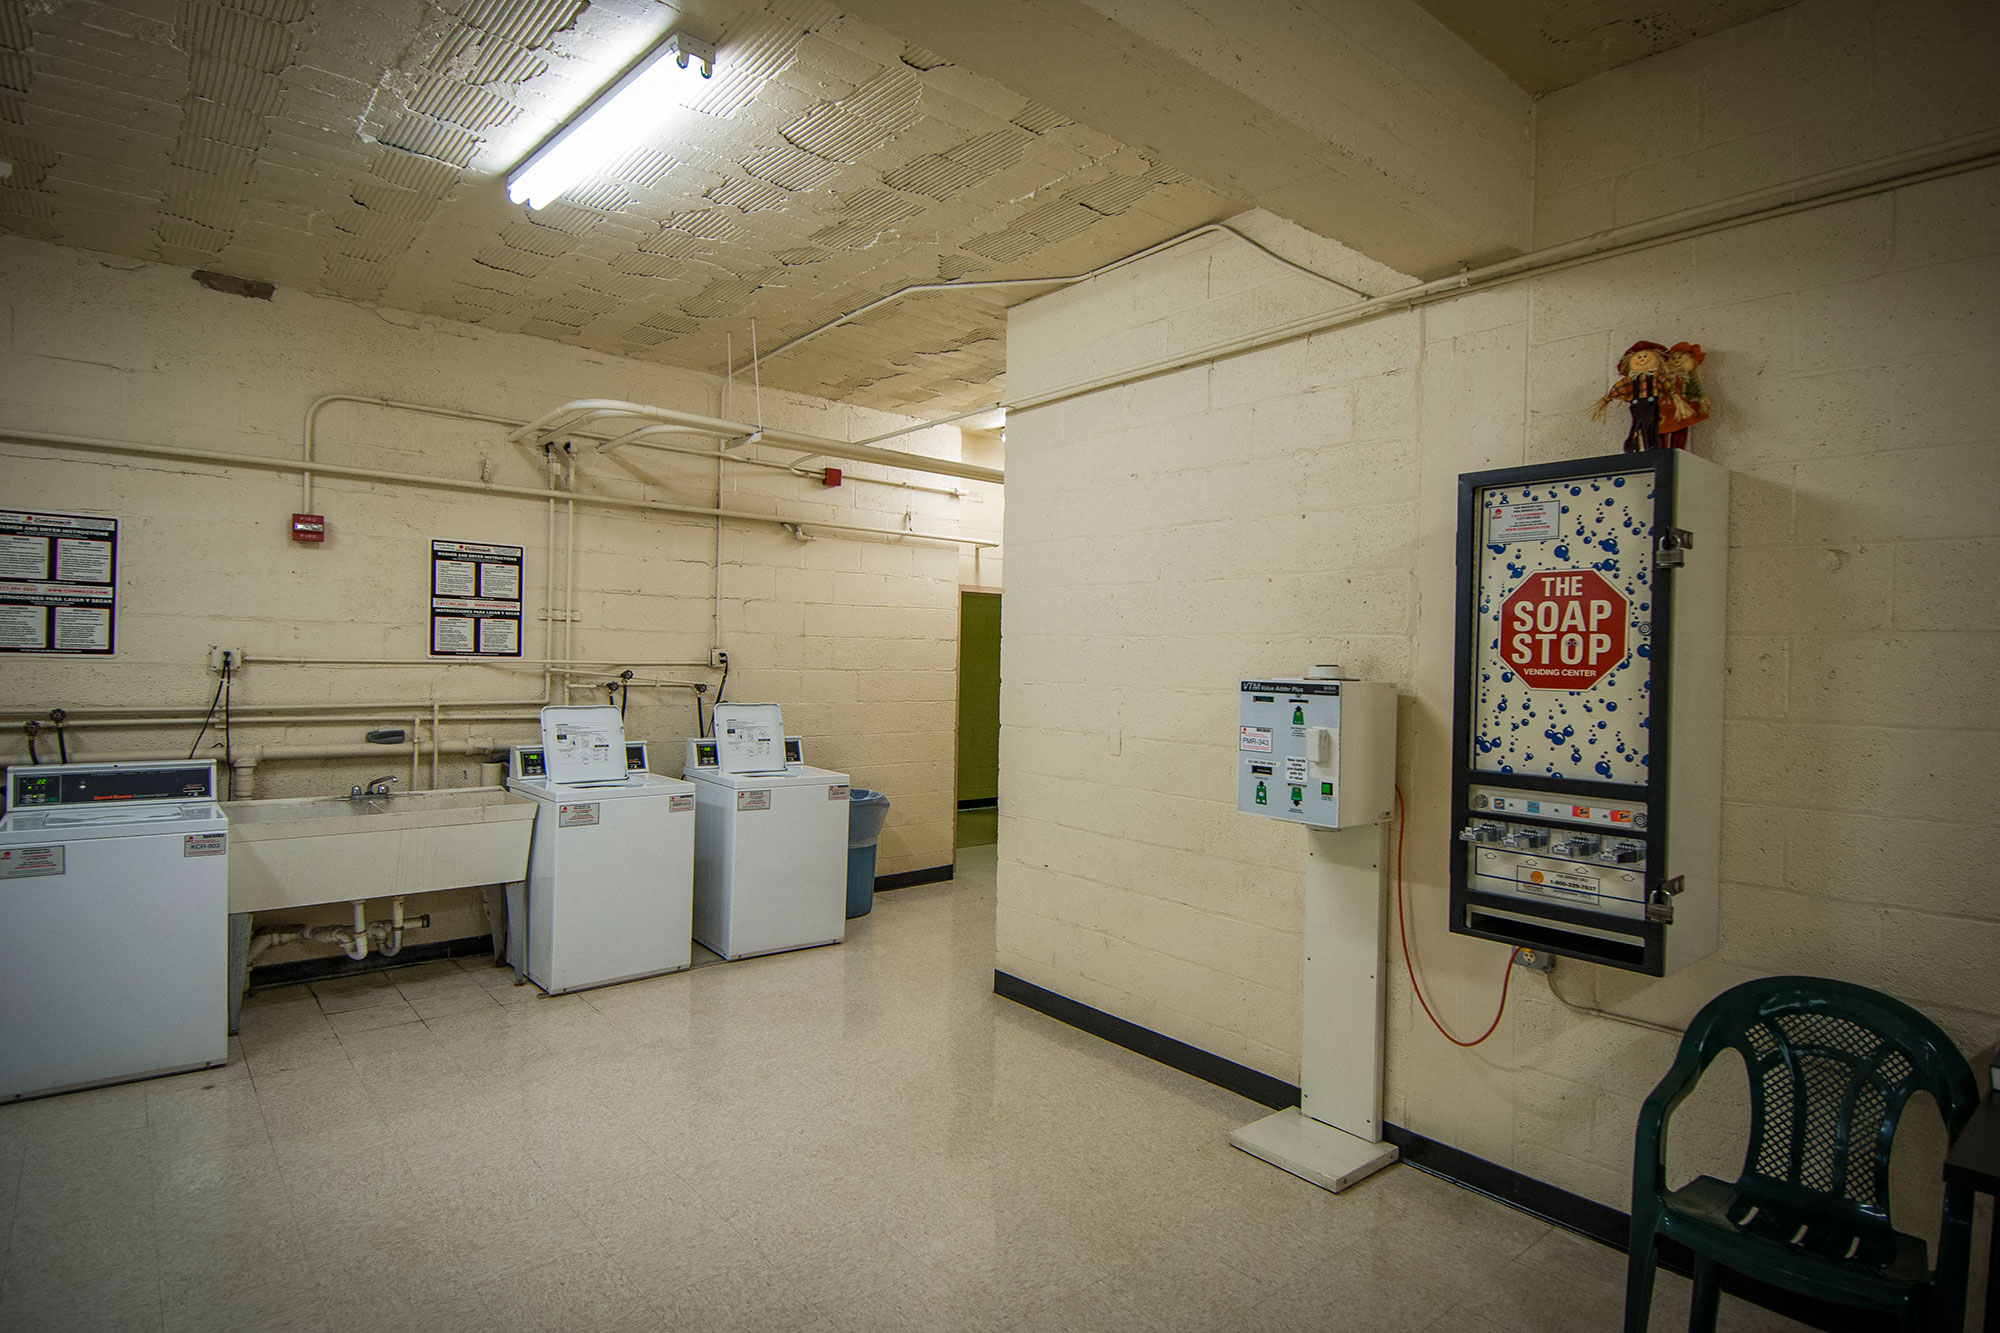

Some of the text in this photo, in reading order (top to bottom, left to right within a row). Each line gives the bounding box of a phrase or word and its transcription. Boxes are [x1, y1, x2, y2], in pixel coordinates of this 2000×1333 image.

[1541, 576, 1583, 597] THE
[1513, 600, 1612, 632] SOAP
[1511, 632, 1612, 665] STOP
[1524, 668, 1596, 677] VENDING CENTER
[1243, 682, 1261, 691] VTM
[1242, 736, 1270, 746] PMR-343
